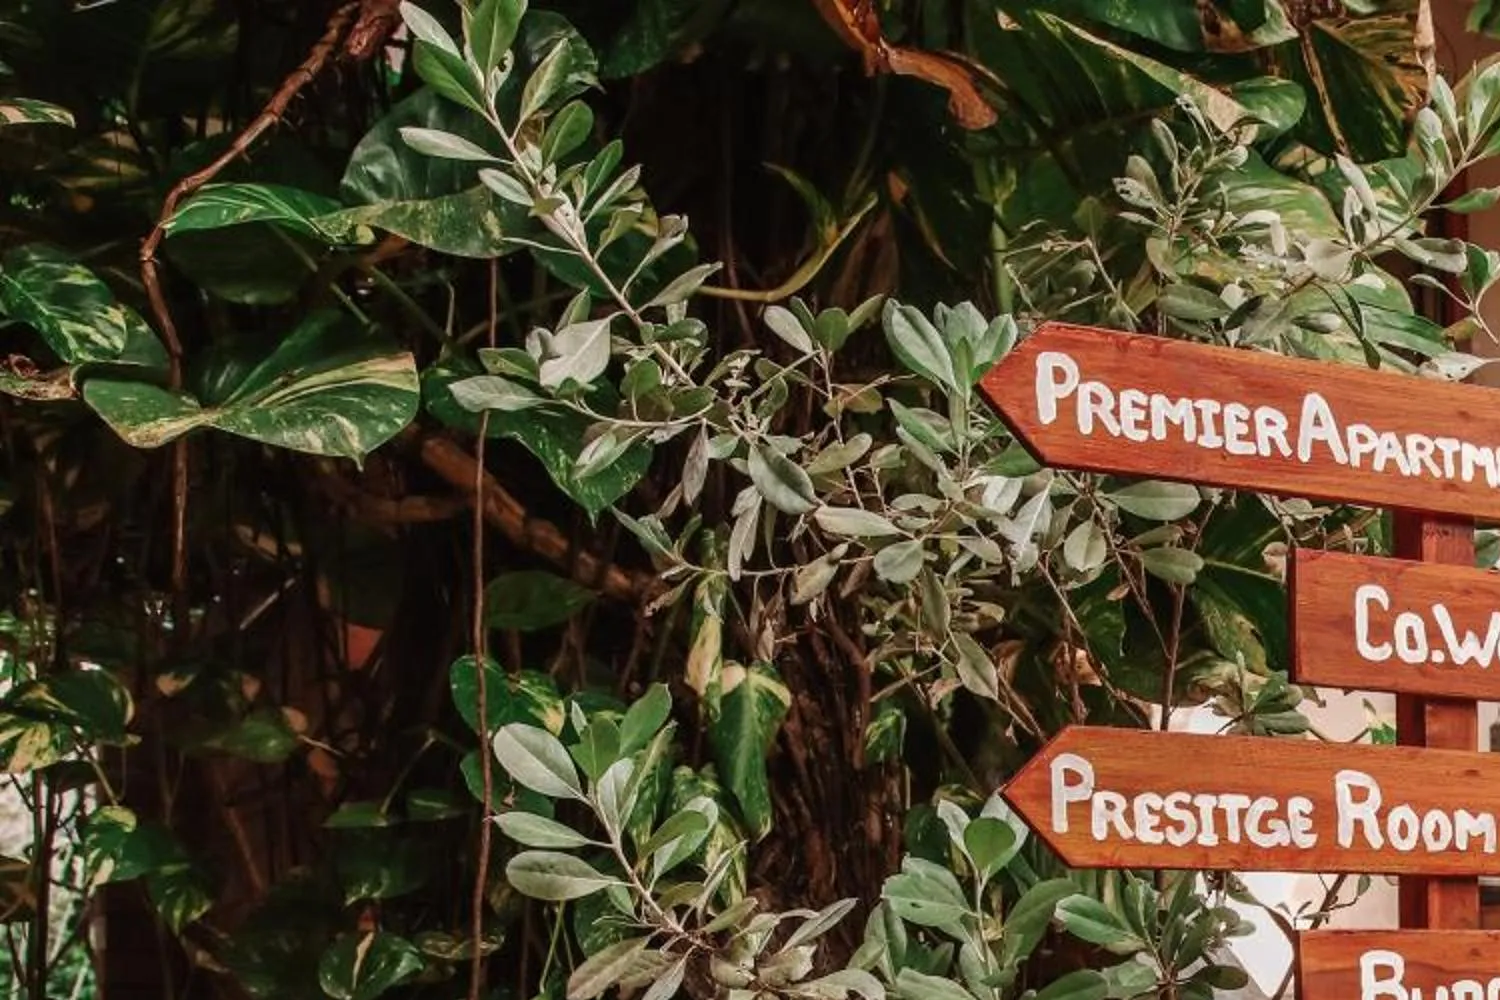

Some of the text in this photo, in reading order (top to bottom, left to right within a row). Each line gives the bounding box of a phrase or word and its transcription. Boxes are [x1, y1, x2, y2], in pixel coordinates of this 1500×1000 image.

[1034, 350, 1294, 459] PREMIER
[1049, 752, 1498, 855] PRESITGE ROOM
